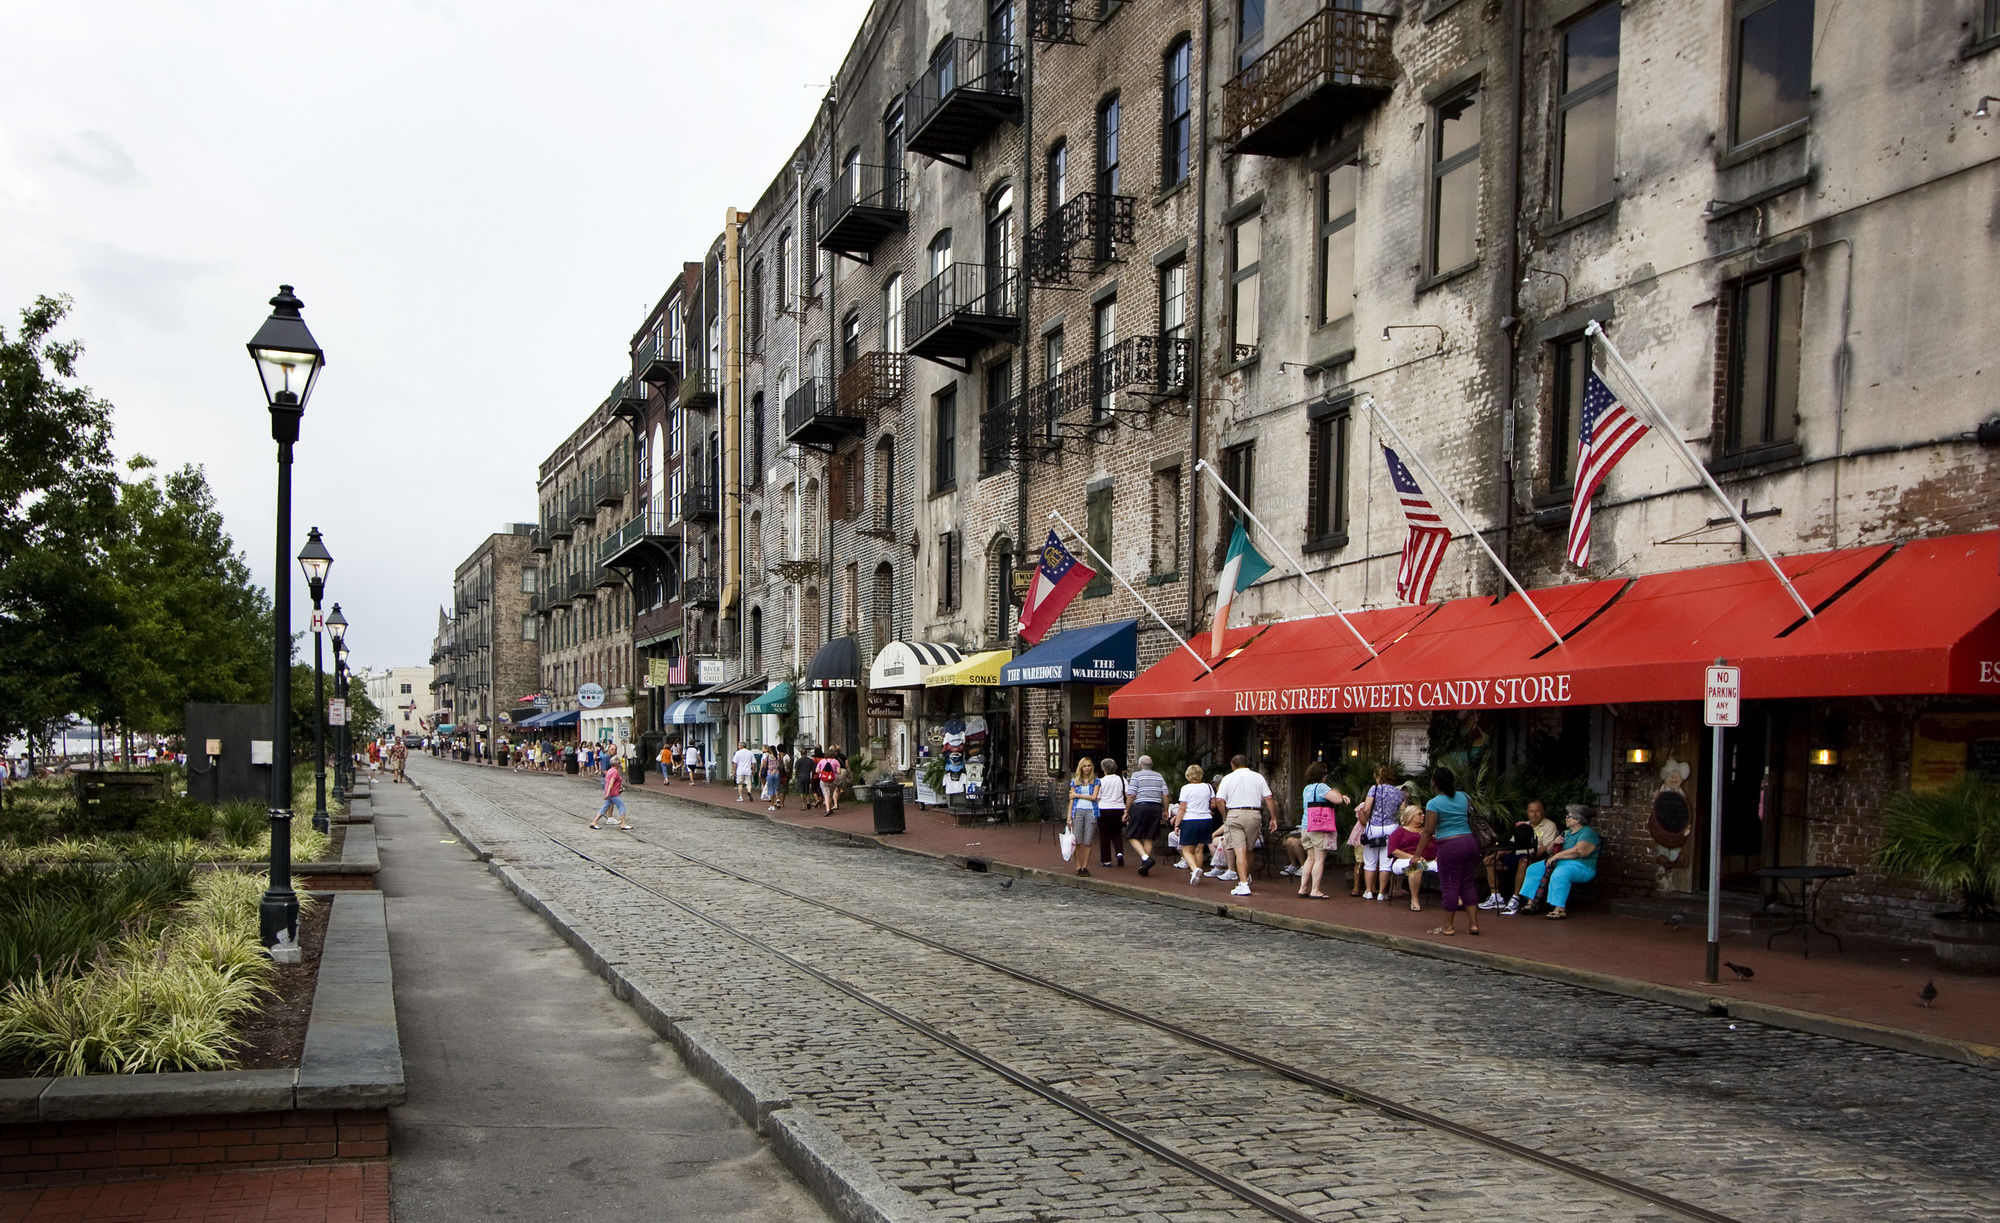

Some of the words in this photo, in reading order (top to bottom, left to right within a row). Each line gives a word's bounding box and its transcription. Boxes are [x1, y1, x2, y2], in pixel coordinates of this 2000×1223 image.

[313, 614, 322, 627] H
[1093, 659, 1115, 669] THE
[1007, 668, 1021, 682] THE
[1022, 665, 1063, 680] WAREHOUSE
[1072, 668, 1136, 679] WAREHOUSE
[1717, 671, 1729, 683] NO
[811, 678, 858, 688] JEZEBEL
[1234, 690, 1277, 712] RIVER
[1280, 687, 1340, 711] STREET
[1343, 683, 1413, 709] SWEETS
[1417, 679, 1491, 707] CANDY
[1494, 674, 1572, 704] STORE
[1708, 686, 1737, 698] PARKING
[1715, 713, 1729, 721] TIME
